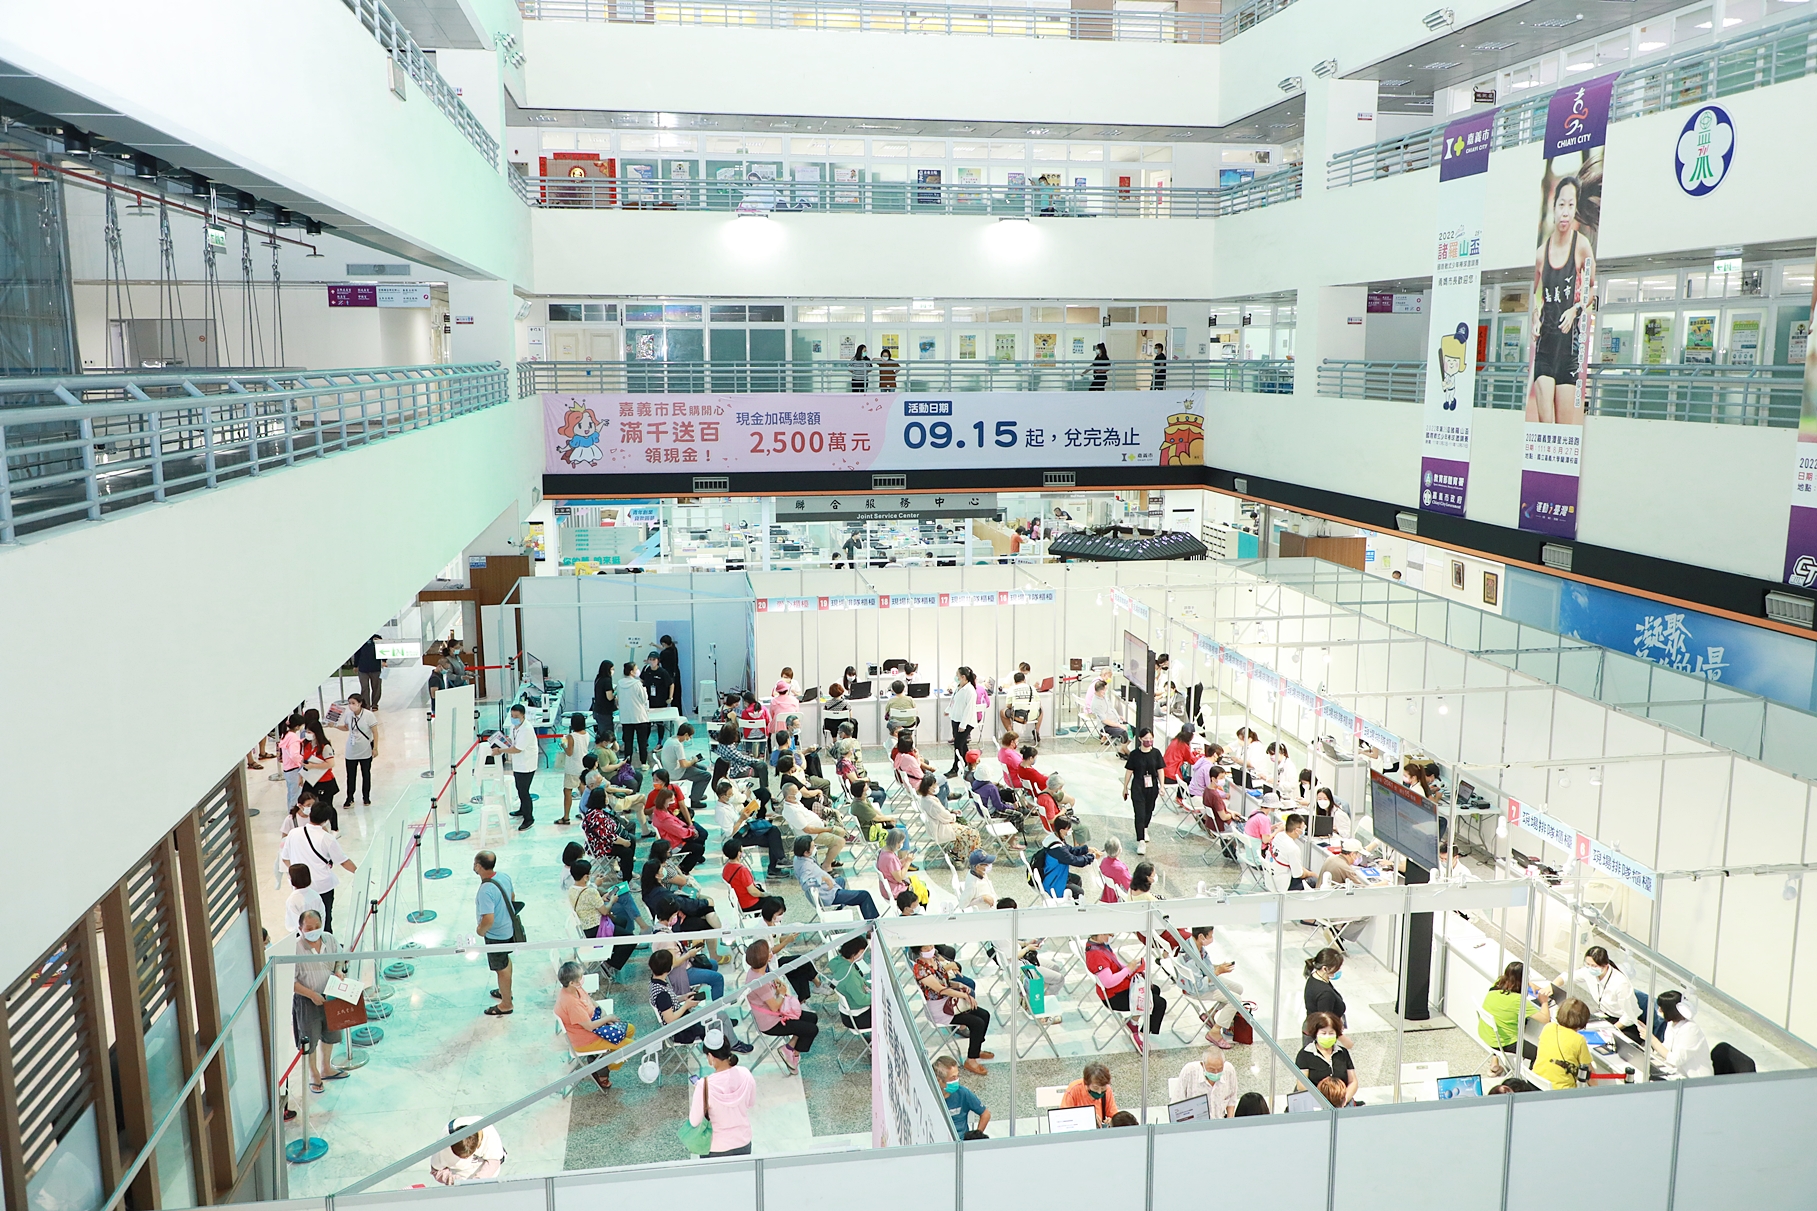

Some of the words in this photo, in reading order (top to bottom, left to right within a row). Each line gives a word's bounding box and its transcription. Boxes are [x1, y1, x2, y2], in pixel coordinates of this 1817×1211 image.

[1467, 129, 1490, 145] 嘉義市
[1557, 137, 1577, 148] CHIAYI
[1577, 133, 1591, 143] CITY
[1439, 231, 1455, 240] 2022
[1438, 238, 1480, 260] 諸羅山盃
[1545, 285, 1572, 303] 嘉義市
[619, 401, 725, 418] 嘉義市民購開心
[908, 402, 950, 415] 活動日期
[736, 411, 822, 427] 現金加碼總額
[620, 421, 721, 444] 滿千送百
[904, 421, 1018, 449] 09.15
[1025, 427, 1141, 448] 起，兌完為止
[750, 430, 871, 455] 2,500萬元
[645, 447, 712, 464] 領現金！
[795, 497, 980, 511] 聯合服務中心
[757, 601, 766, 609] 20
[820, 599, 828, 607] 19
[941, 596, 948, 604] 17
[1633, 613, 1693, 661] 凝聚
[1511, 804, 1517, 819] 7
[1522, 811, 1573, 850] 現場排隊櫃檯
[1580, 842, 1586, 856] 6
[1592, 848, 1652, 893] 現場排隊櫃檯
